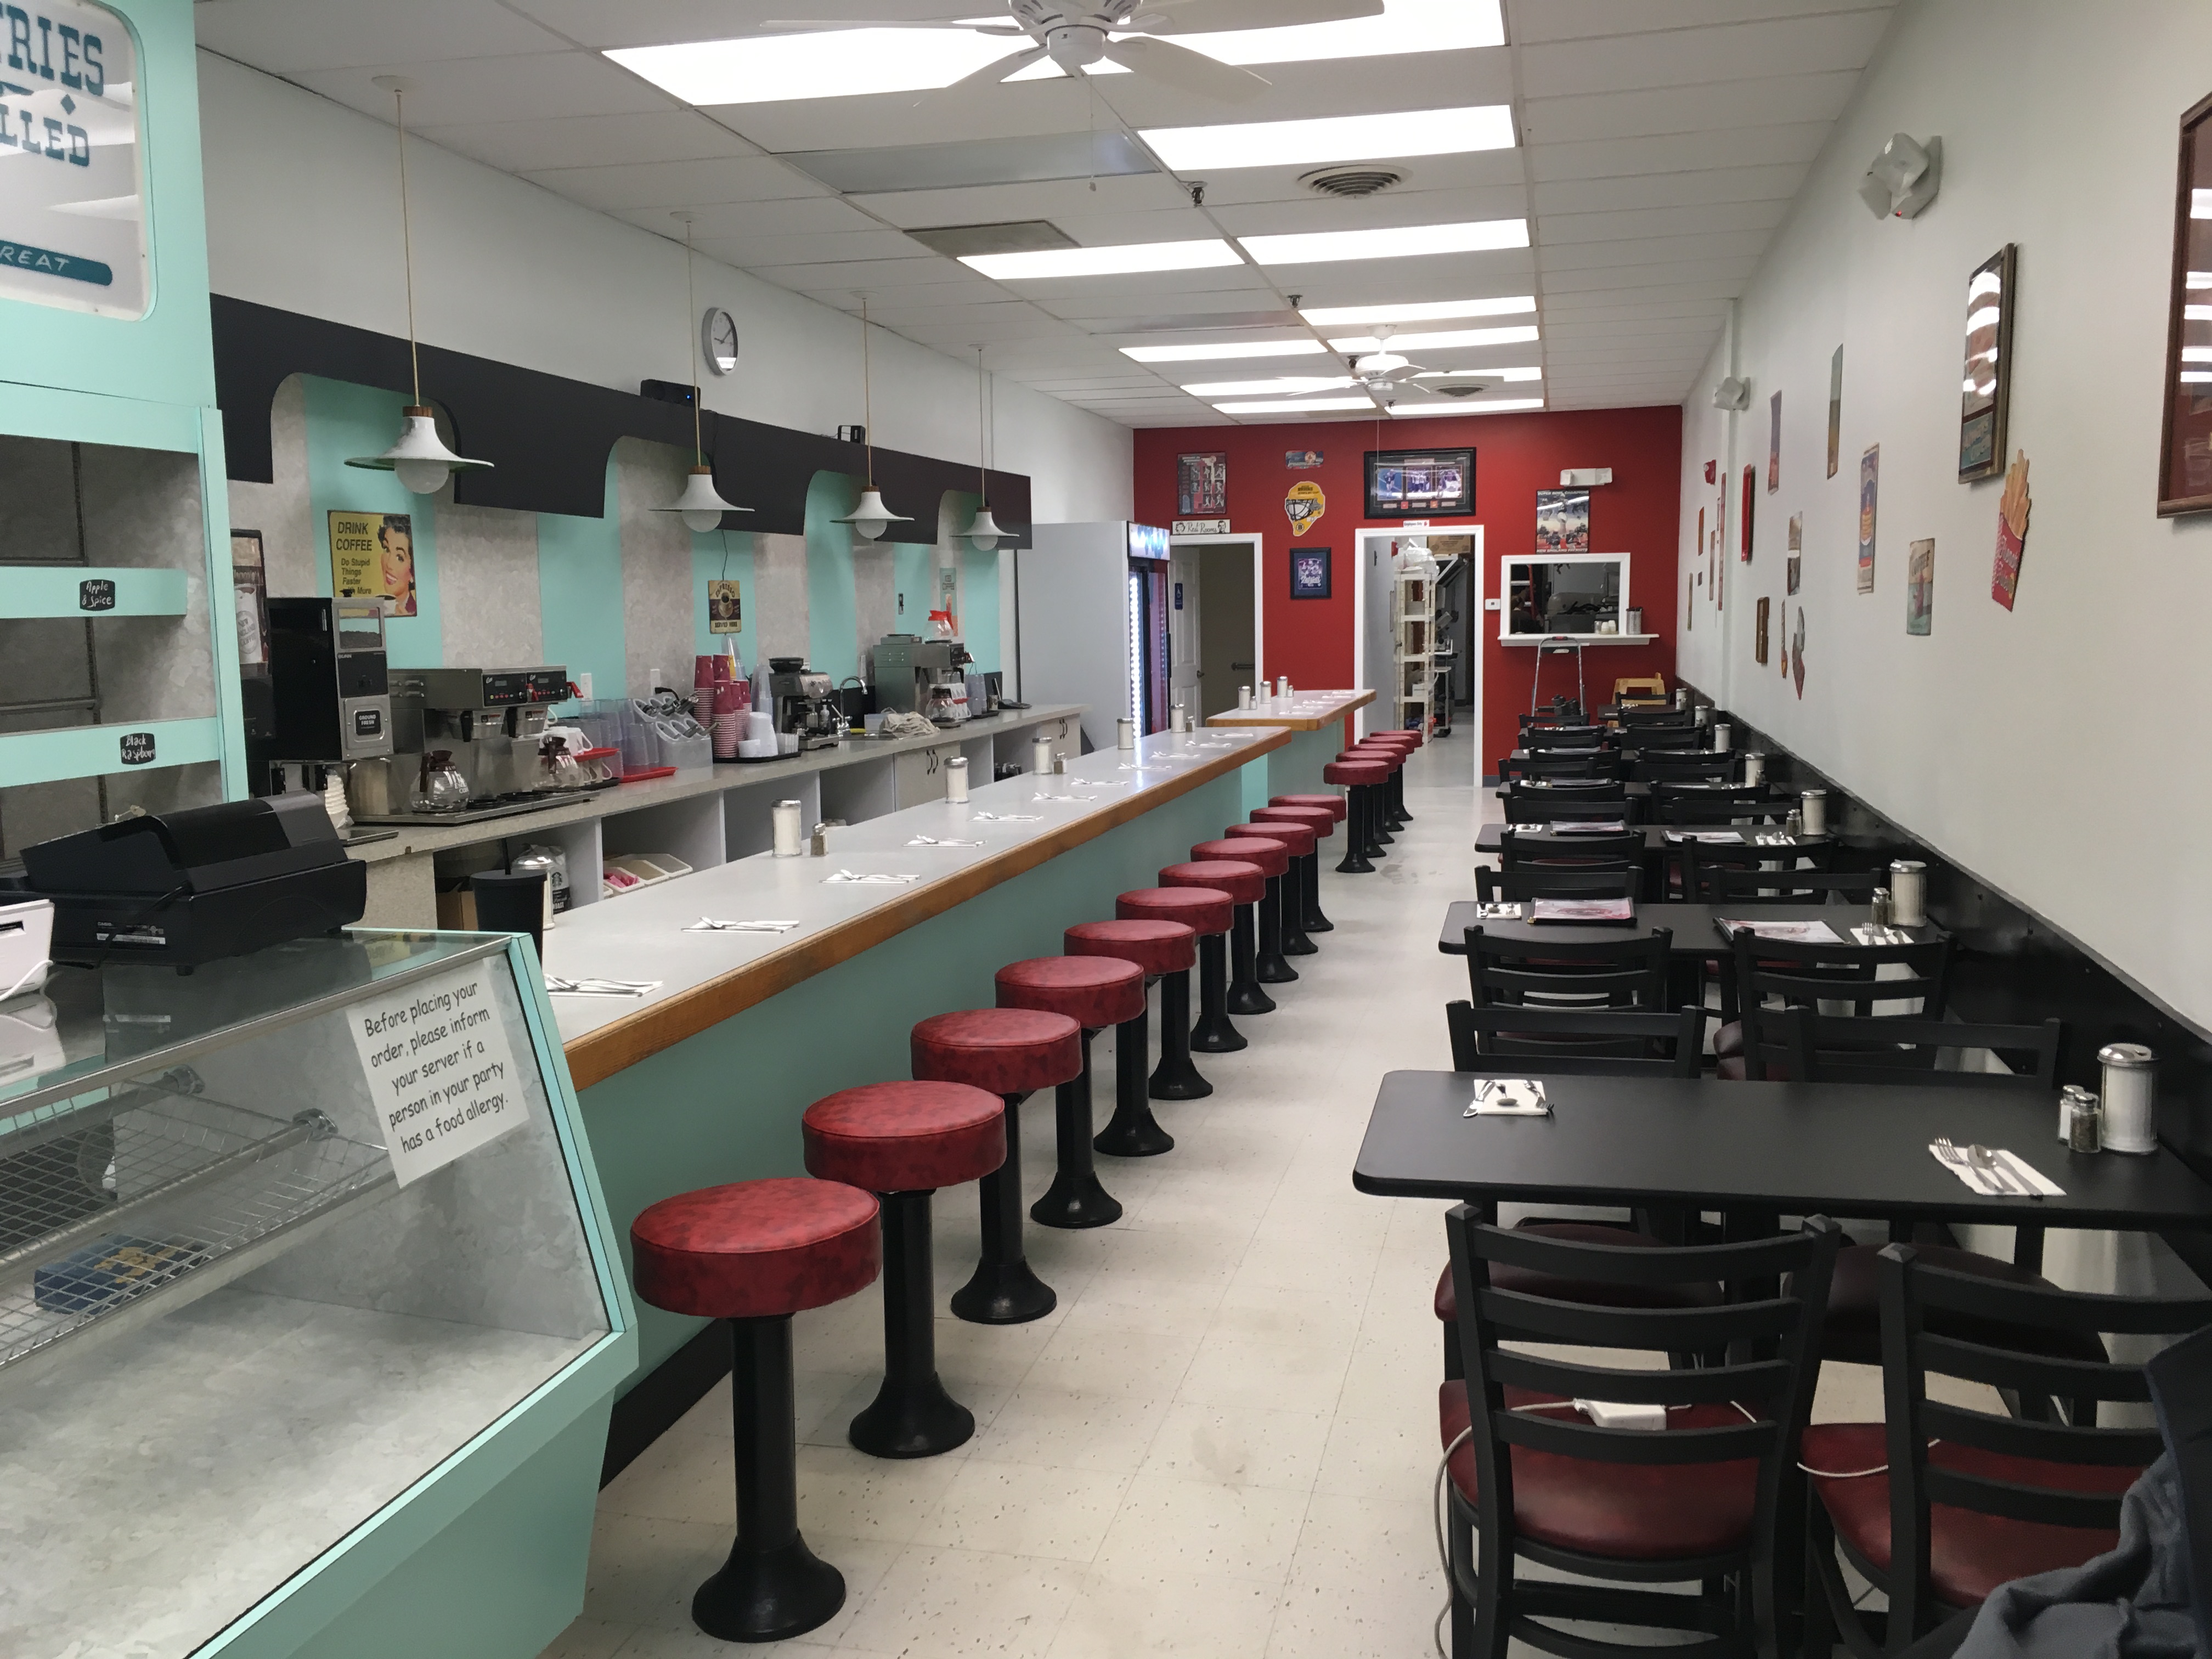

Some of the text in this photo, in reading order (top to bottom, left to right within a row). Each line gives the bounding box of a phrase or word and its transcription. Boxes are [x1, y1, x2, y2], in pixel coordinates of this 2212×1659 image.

[0, 3, 104, 97] RIES
[0, 245, 70, 272] REAT
[338, 521, 369, 535] DRINK
[336, 538, 373, 551] COFFEE
[351, 558, 370, 568] Stupid
[342, 568, 362, 577] Things
[86, 580, 109, 594] Apple
[342, 586, 372, 595] ith More
[87, 595, 112, 608] Spice
[125, 733, 146, 747] Black
[364, 982, 478, 1037] Before placing your
[371, 1008, 490, 1068] order, please inform
[391, 1040, 485, 1096] your server if a
[388, 1062, 504, 1132] person in your party
[400, 1093, 509, 1154] has a food allergy.
